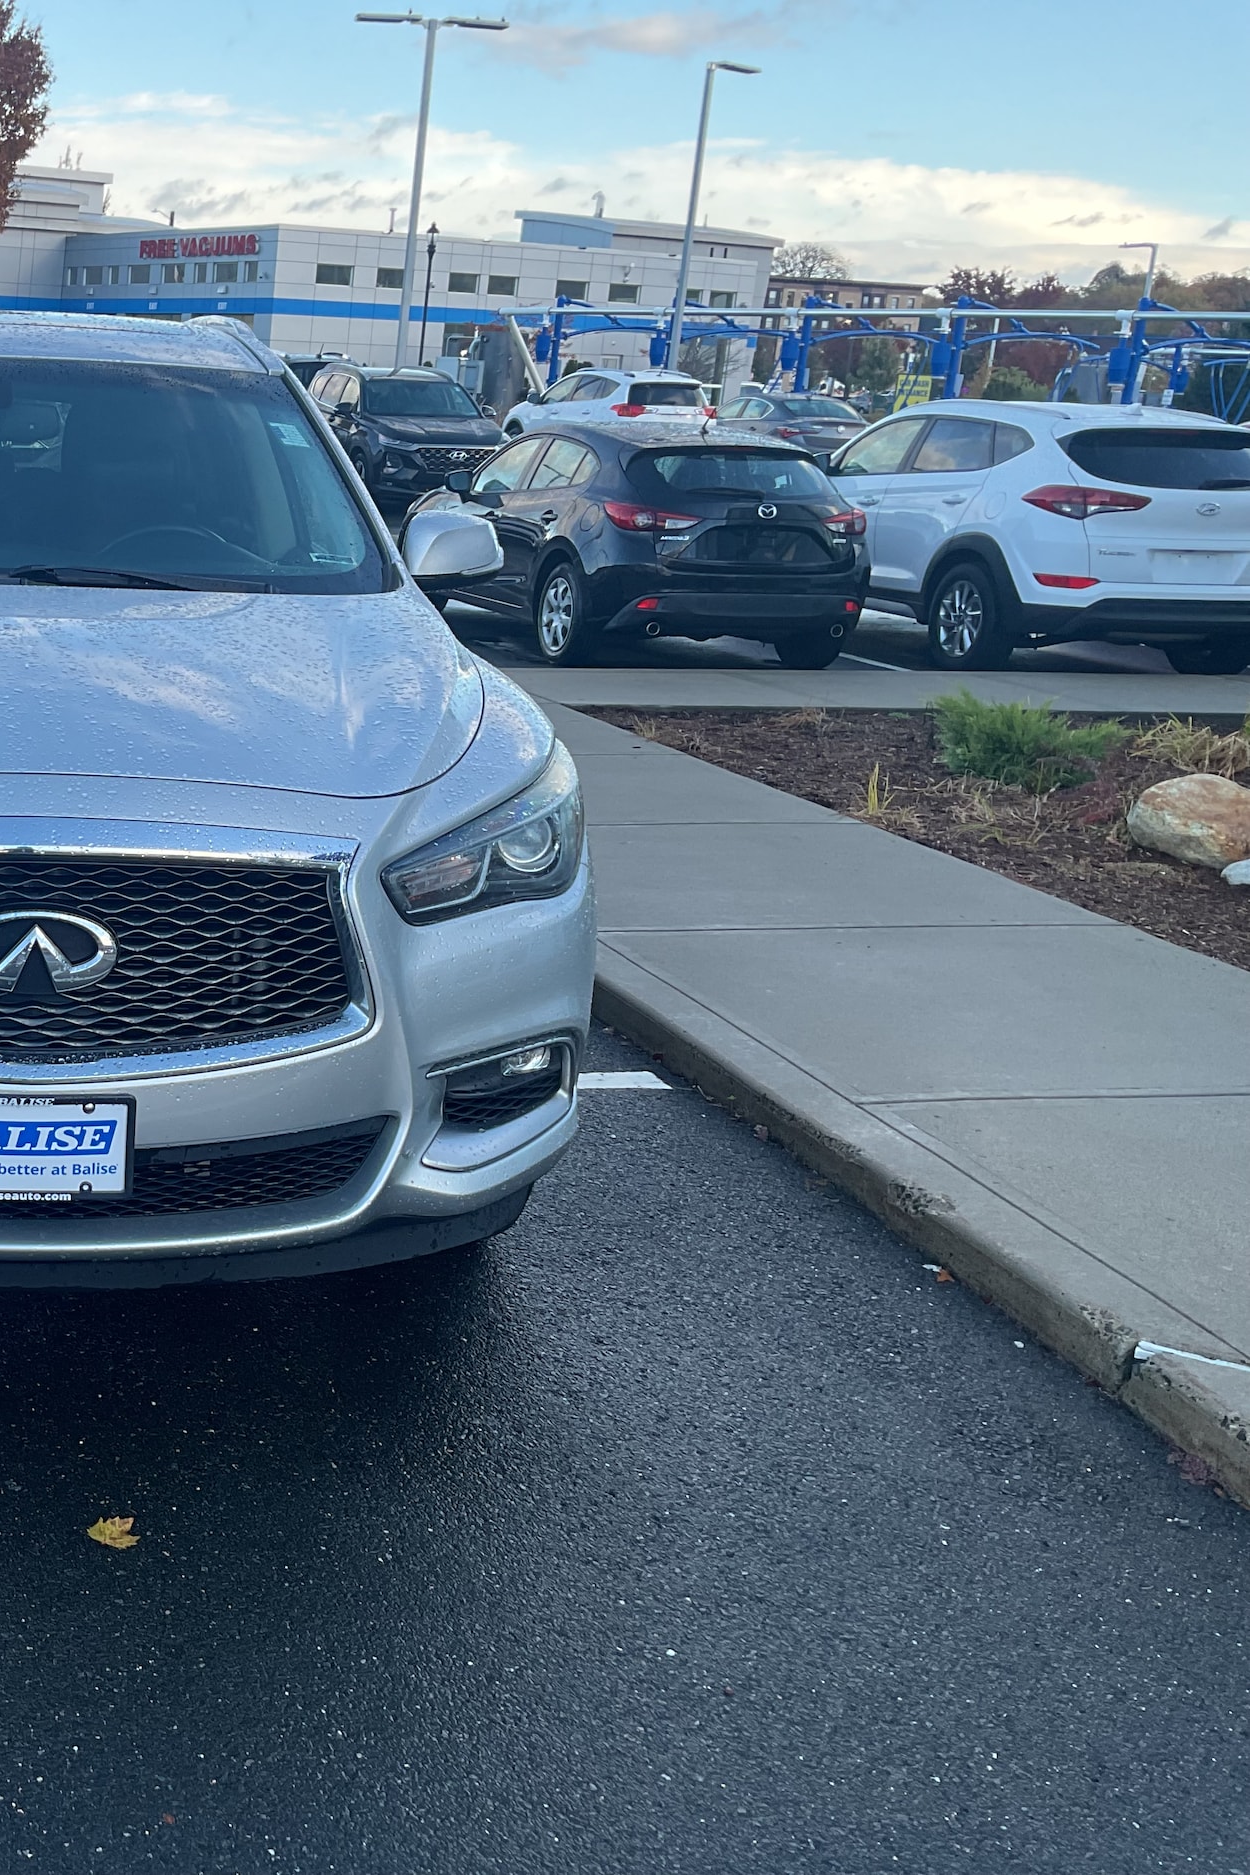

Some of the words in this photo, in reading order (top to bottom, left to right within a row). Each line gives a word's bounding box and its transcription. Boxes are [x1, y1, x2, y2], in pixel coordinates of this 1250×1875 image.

[139, 239, 178, 258] FREE
[179, 234, 258, 257] VACUUMS
[51, 1164, 67, 1175] at
[72, 1163, 117, 1175] Balise
